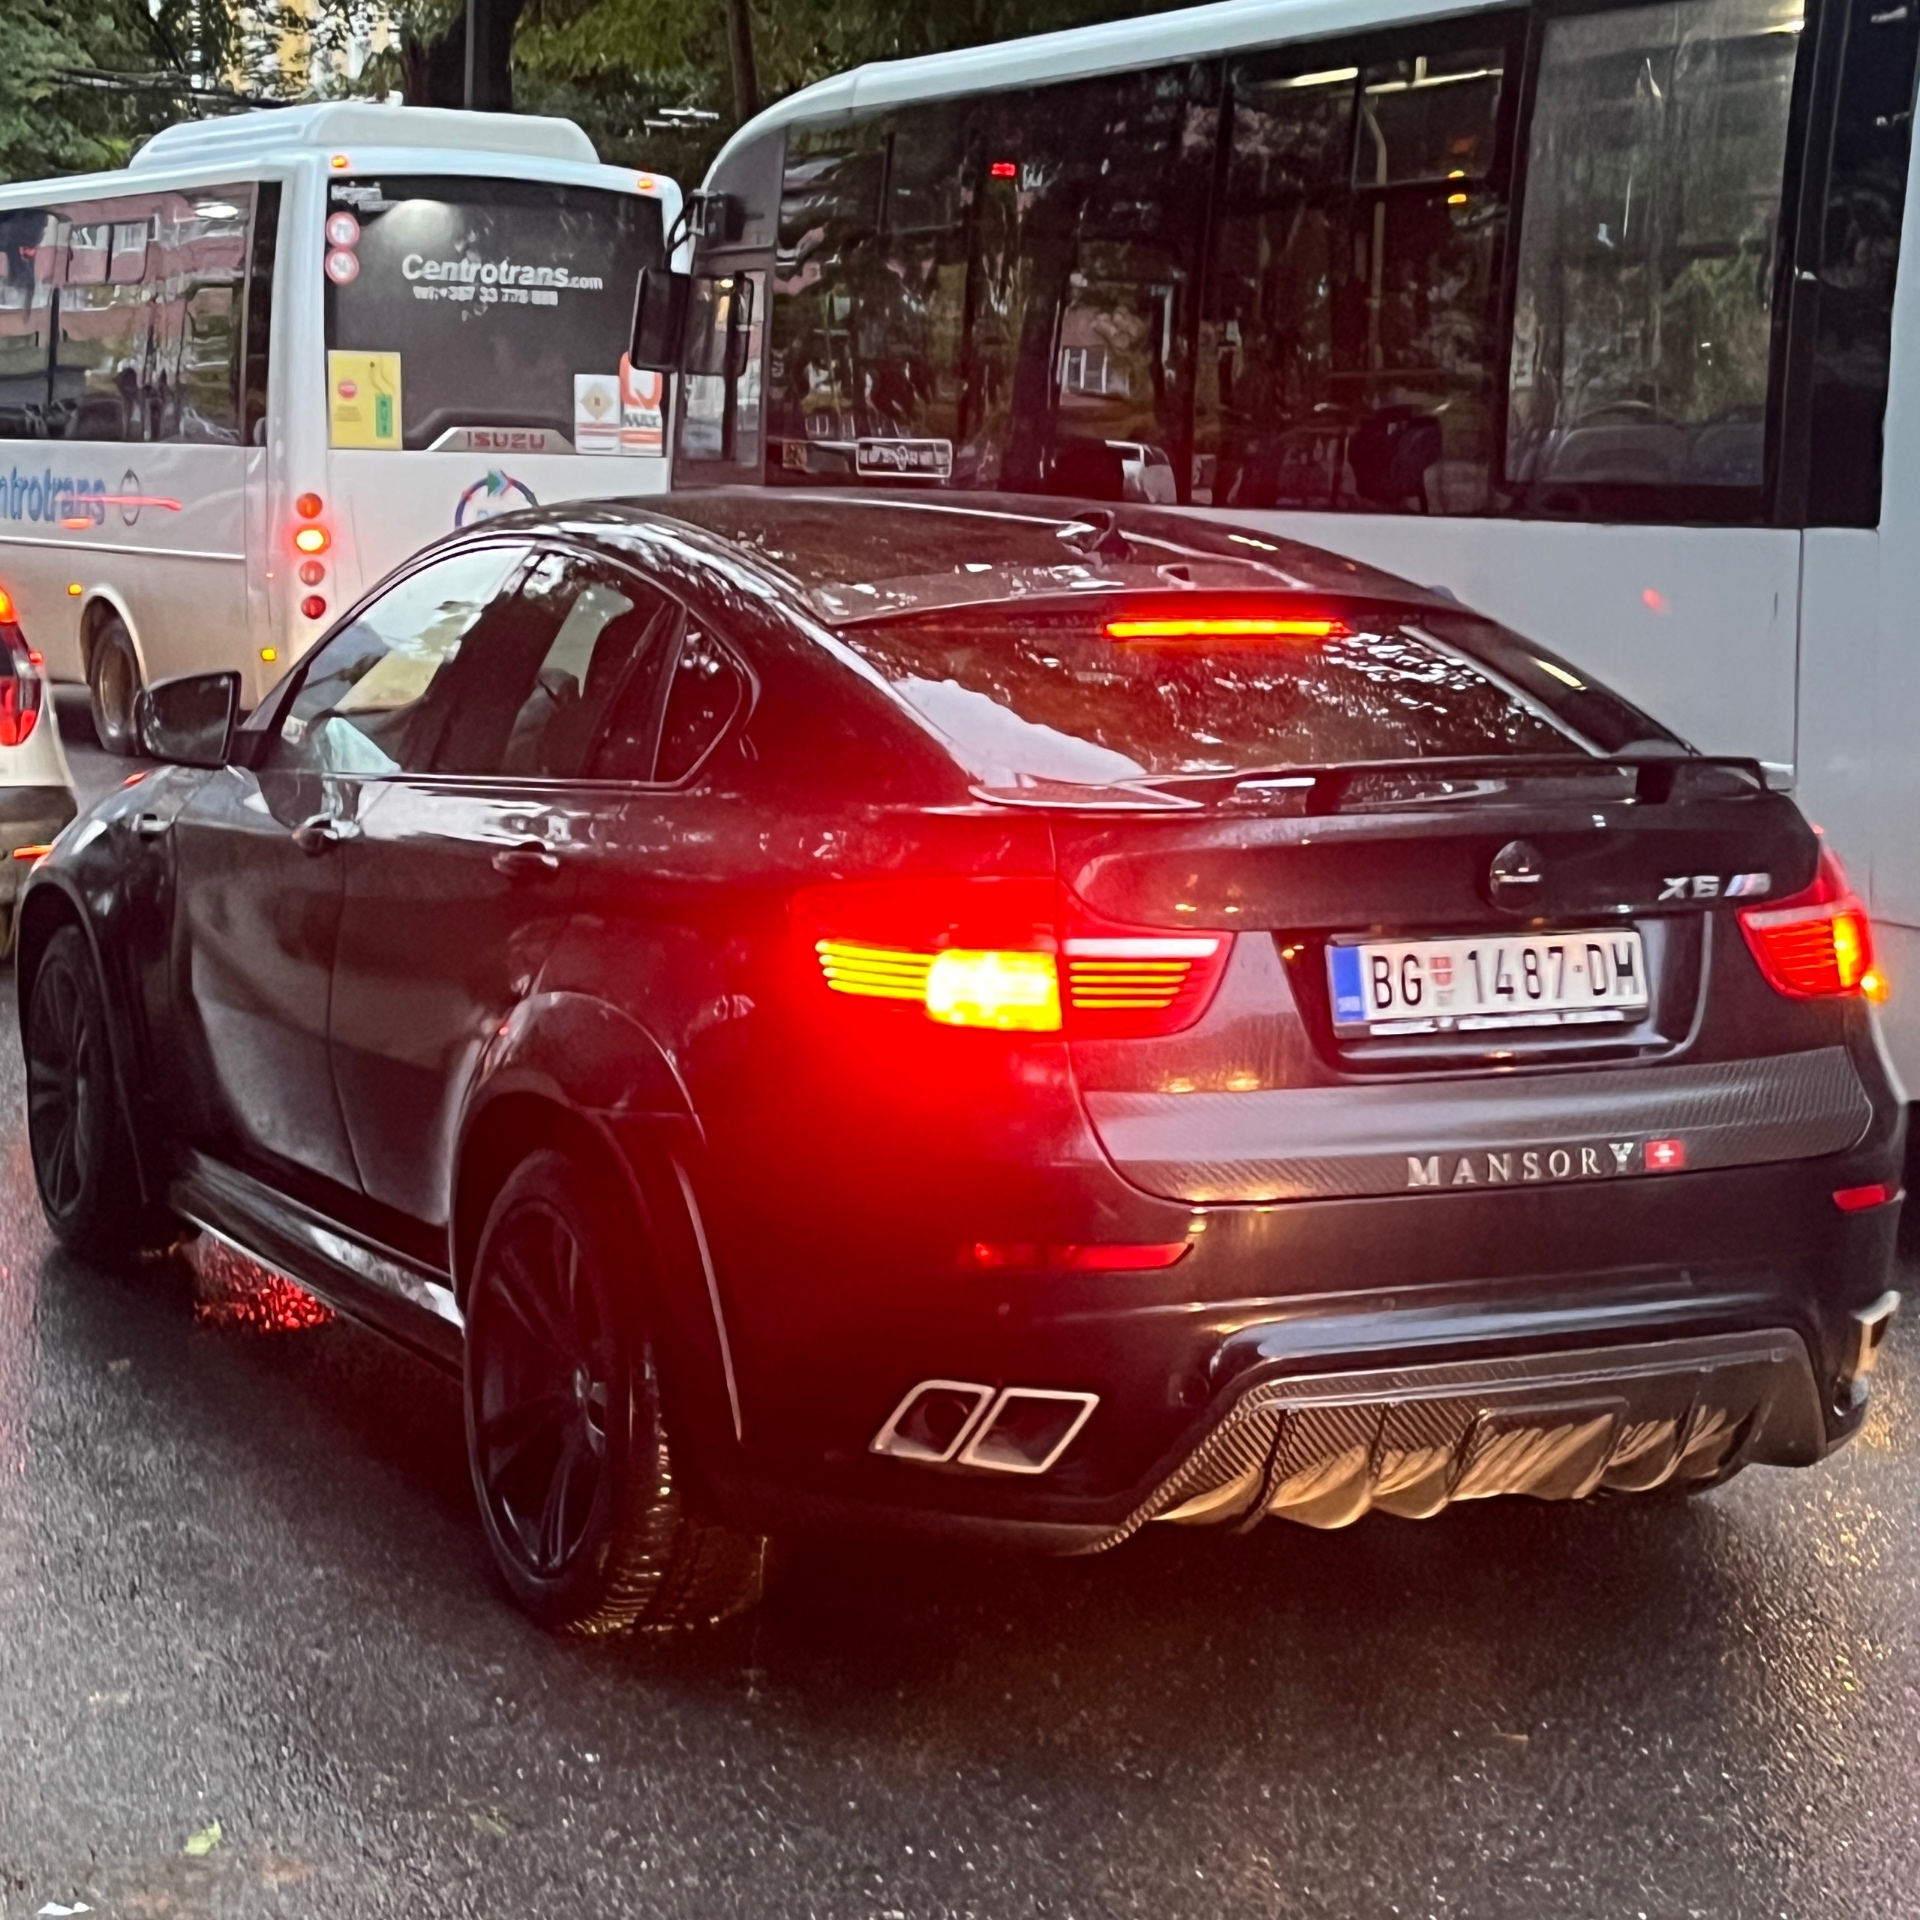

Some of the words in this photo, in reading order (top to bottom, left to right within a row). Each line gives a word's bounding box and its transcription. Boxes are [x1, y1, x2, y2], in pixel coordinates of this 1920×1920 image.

[402, 254, 603, 290] Centrotrans.com
[467, 431, 545, 449] ISUZU
[1657, 875, 1720, 901] X6
[1372, 954, 1422, 1009] BG
[1406, 1142, 1634, 1187] MANSORY
